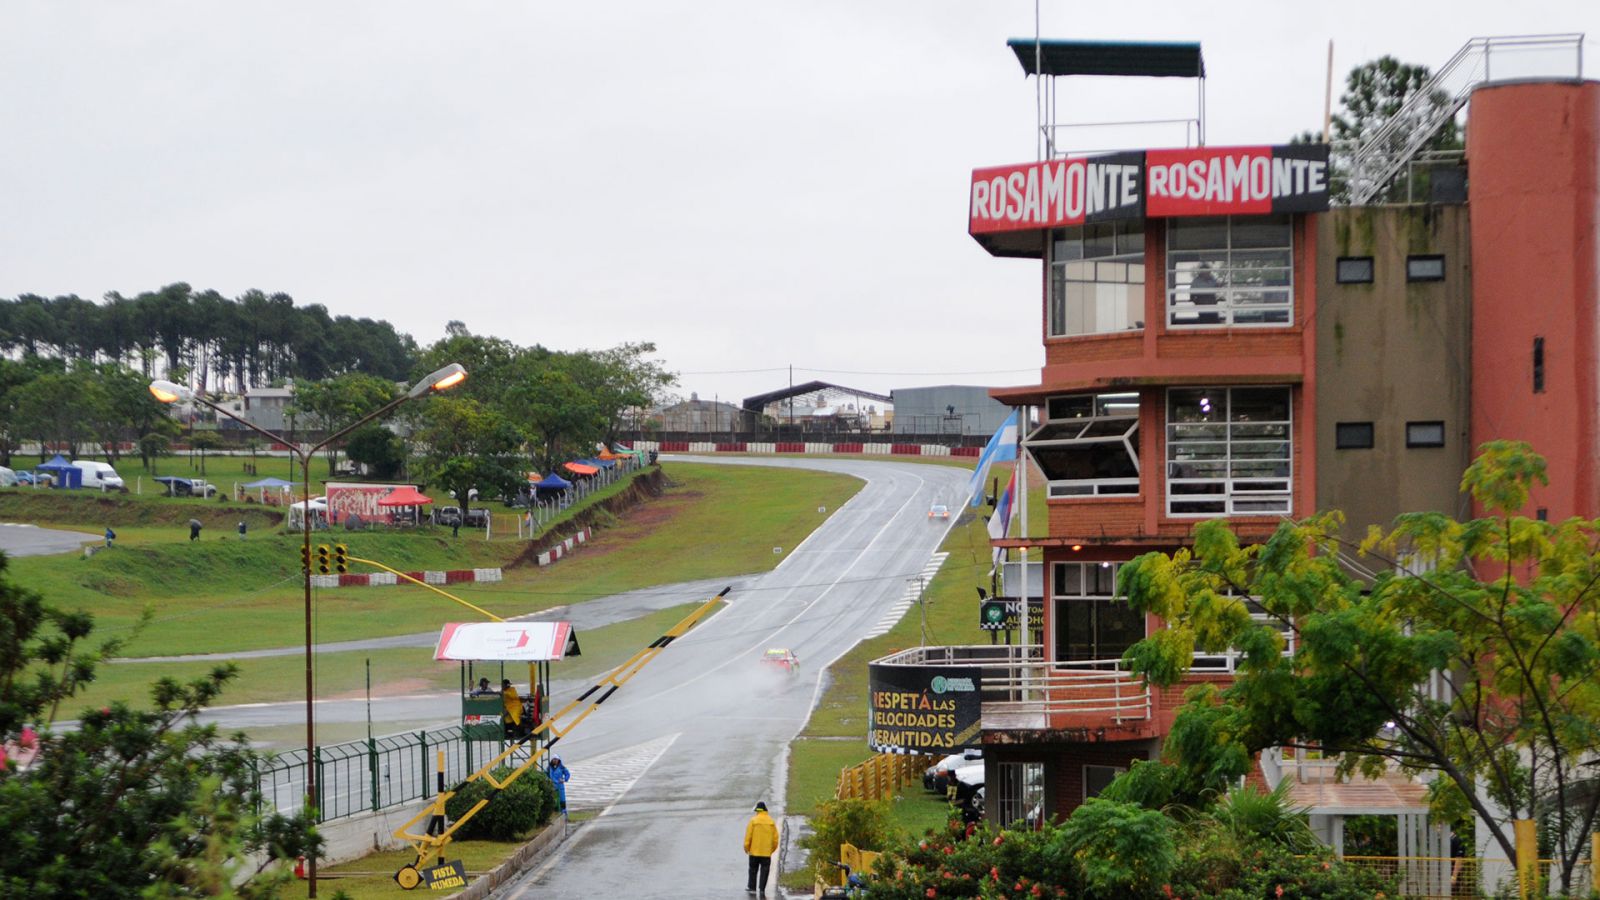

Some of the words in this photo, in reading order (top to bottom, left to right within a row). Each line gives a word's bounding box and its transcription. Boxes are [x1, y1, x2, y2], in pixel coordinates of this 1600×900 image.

[1149, 154, 1326, 203] ROSAMONTE
[972, 162, 1139, 223] ROSAMONTE
[933, 699, 956, 711] LAS
[432, 864, 456, 880] PISTA
[430, 875, 465, 890] HUMEDA
